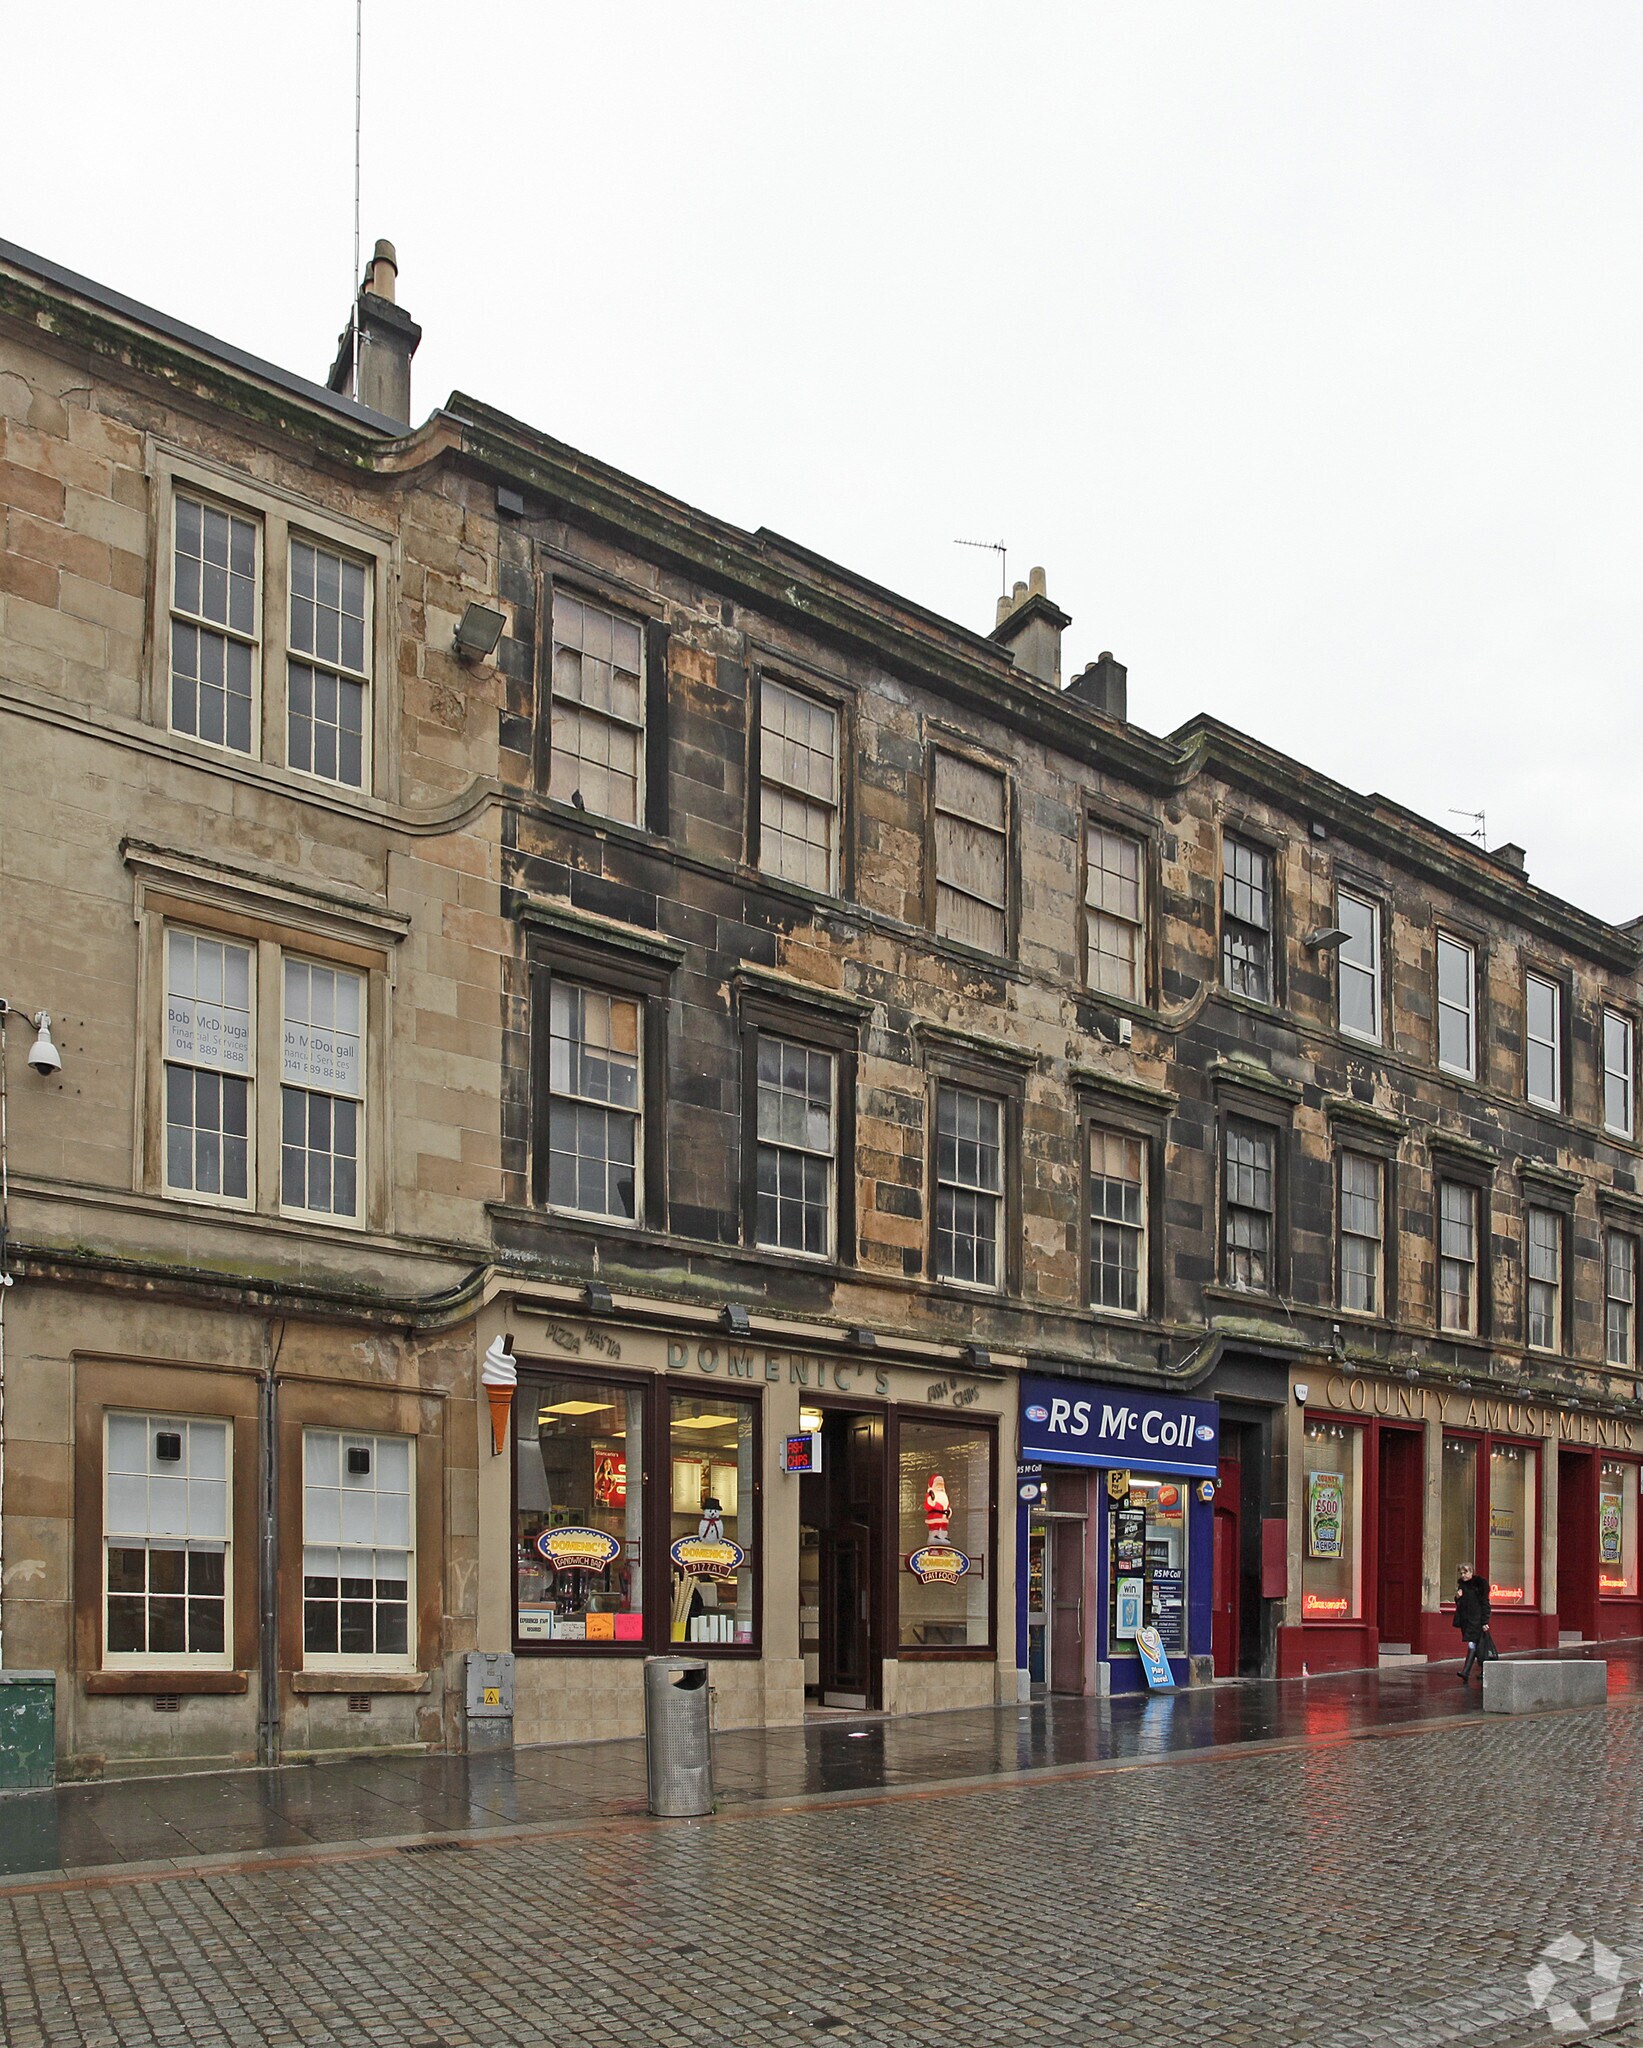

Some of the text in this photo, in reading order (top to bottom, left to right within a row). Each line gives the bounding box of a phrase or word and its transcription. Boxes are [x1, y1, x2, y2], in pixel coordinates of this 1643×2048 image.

[168, 1008, 190, 1024] Bob
[172, 1026, 210, 1043] Finanial
[176, 1039, 194, 1051] 014
[199, 1044, 218, 1056] 889
[316, 1055, 350, 1070] Servces
[546, 1322, 622, 1360] PIZZA PASTA
[667, 1337, 890, 1394] DOMENIC'S
[927, 1380, 949, 1402] FISH
[952, 1385, 980, 1408] CHIPS
[1047, 1398, 1091, 1436] RS
[1326, 1376, 1634, 1449] COUNTY AMUSEMENTS
[787, 1454, 809, 1467] CHIPS
[1216, 1478, 1223, 1489] 3
[1315, 1500, 1338, 1514] £500
[550, 1540, 607, 1552] DOMENIC'S
[1314, 1541, 1340, 1551] JACKPOT
[681, 1547, 733, 1559] DOMENIC'S
[556, 1556, 602, 1569] SANDWICH BAR
[692, 1563, 722, 1573] PIZZAS
[920, 1558, 961, 1567] DOMENIC'S
[938, 1571, 957, 1580] FOOD
[1154, 1569, 1162, 1578] RS
[1123, 1583, 1136, 1593] win
[1150, 1666, 1164, 1676] Play
[1152, 1675, 1169, 1684] here!
